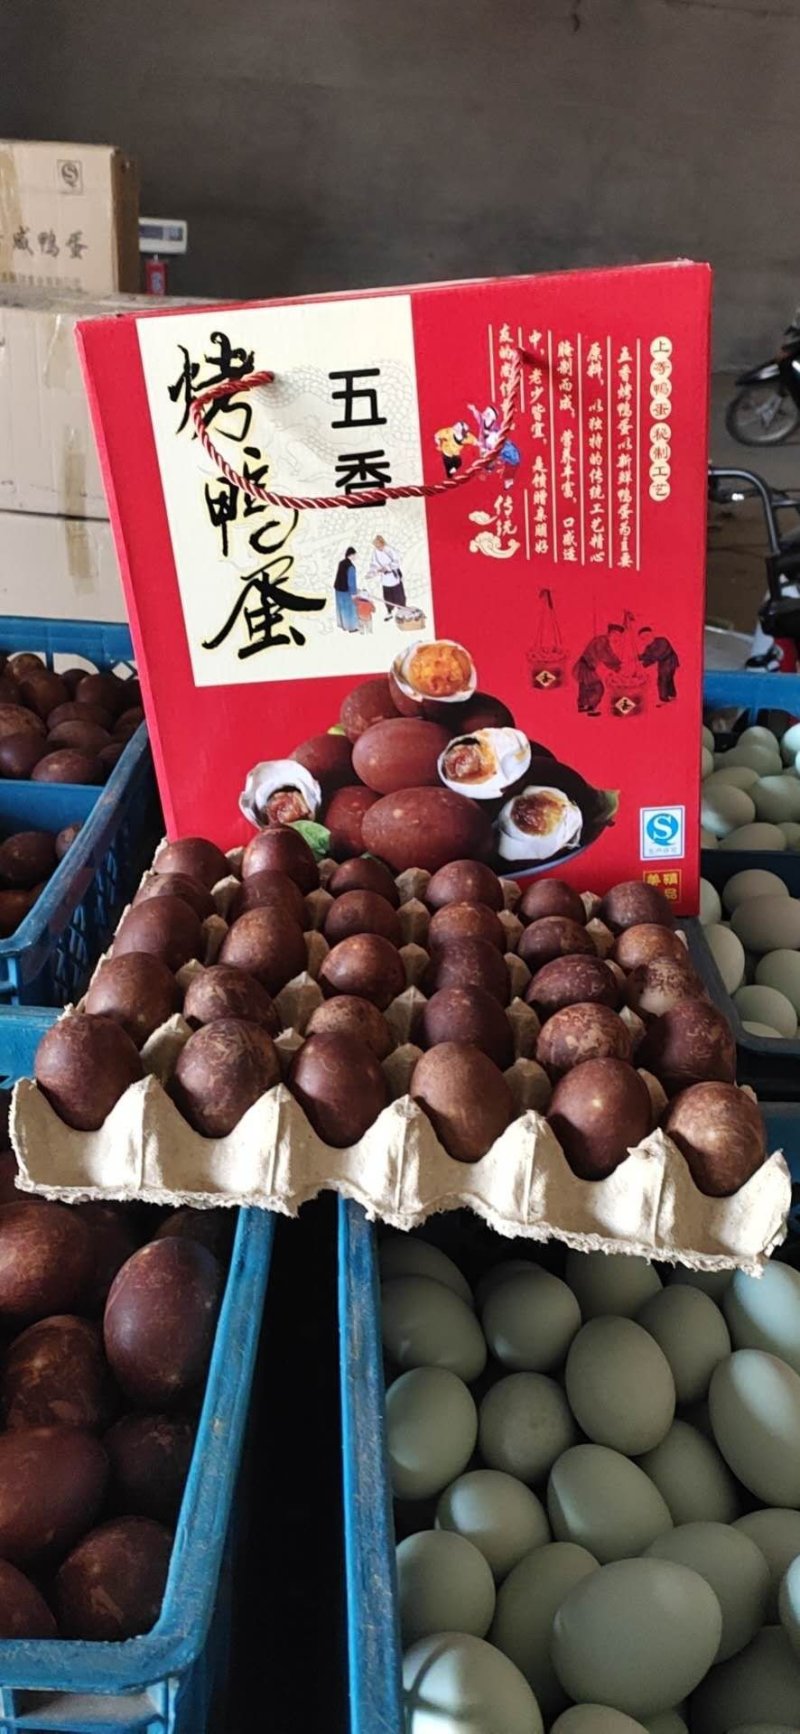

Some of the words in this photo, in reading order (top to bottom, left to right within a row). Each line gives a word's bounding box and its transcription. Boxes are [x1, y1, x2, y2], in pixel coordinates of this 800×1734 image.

[0, 225, 88, 260] 咸鸭蛋
[328, 367, 392, 509] 五香
[168, 331, 327, 660] 烤鸭蛋
[493, 495, 517, 536] 传统
